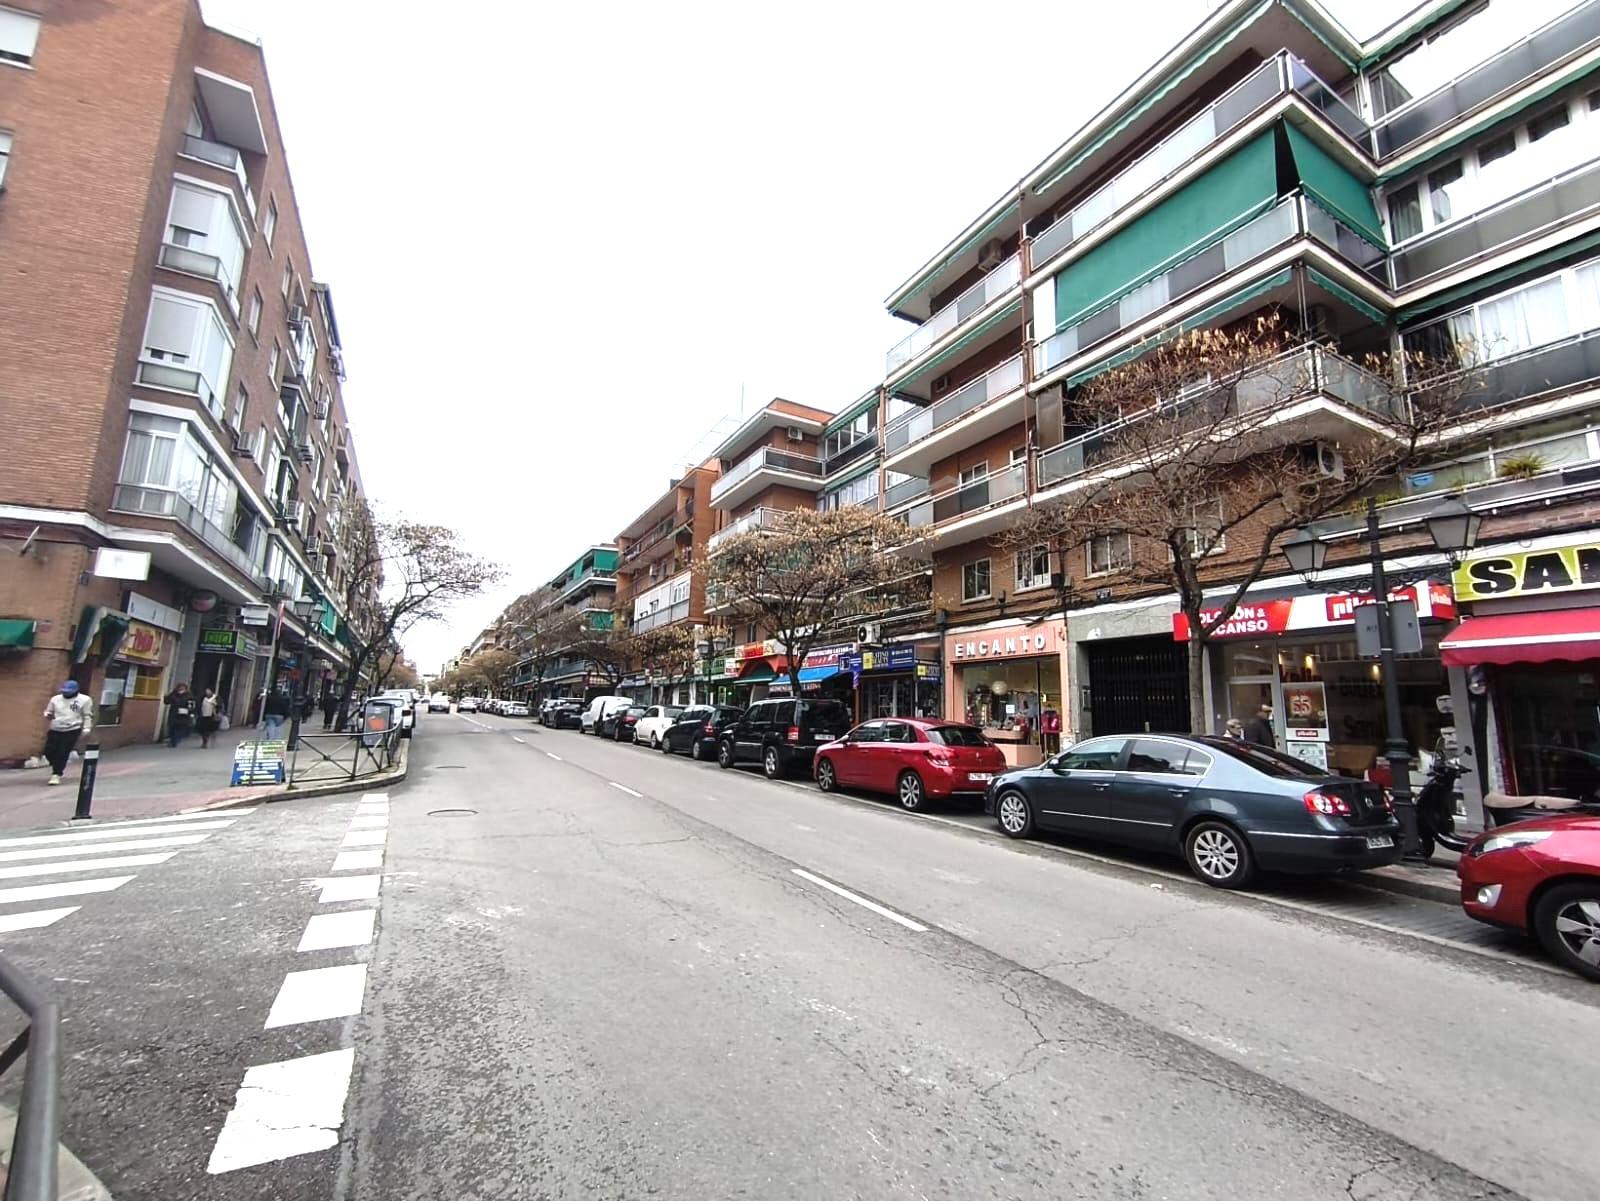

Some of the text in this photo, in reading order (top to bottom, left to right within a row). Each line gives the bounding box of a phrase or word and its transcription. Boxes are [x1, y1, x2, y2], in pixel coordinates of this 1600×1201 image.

[1256, 607, 1266, 618] &
[1188, 620, 1269, 638] CANSO
[955, 634, 1047, 658] ENCANTO
